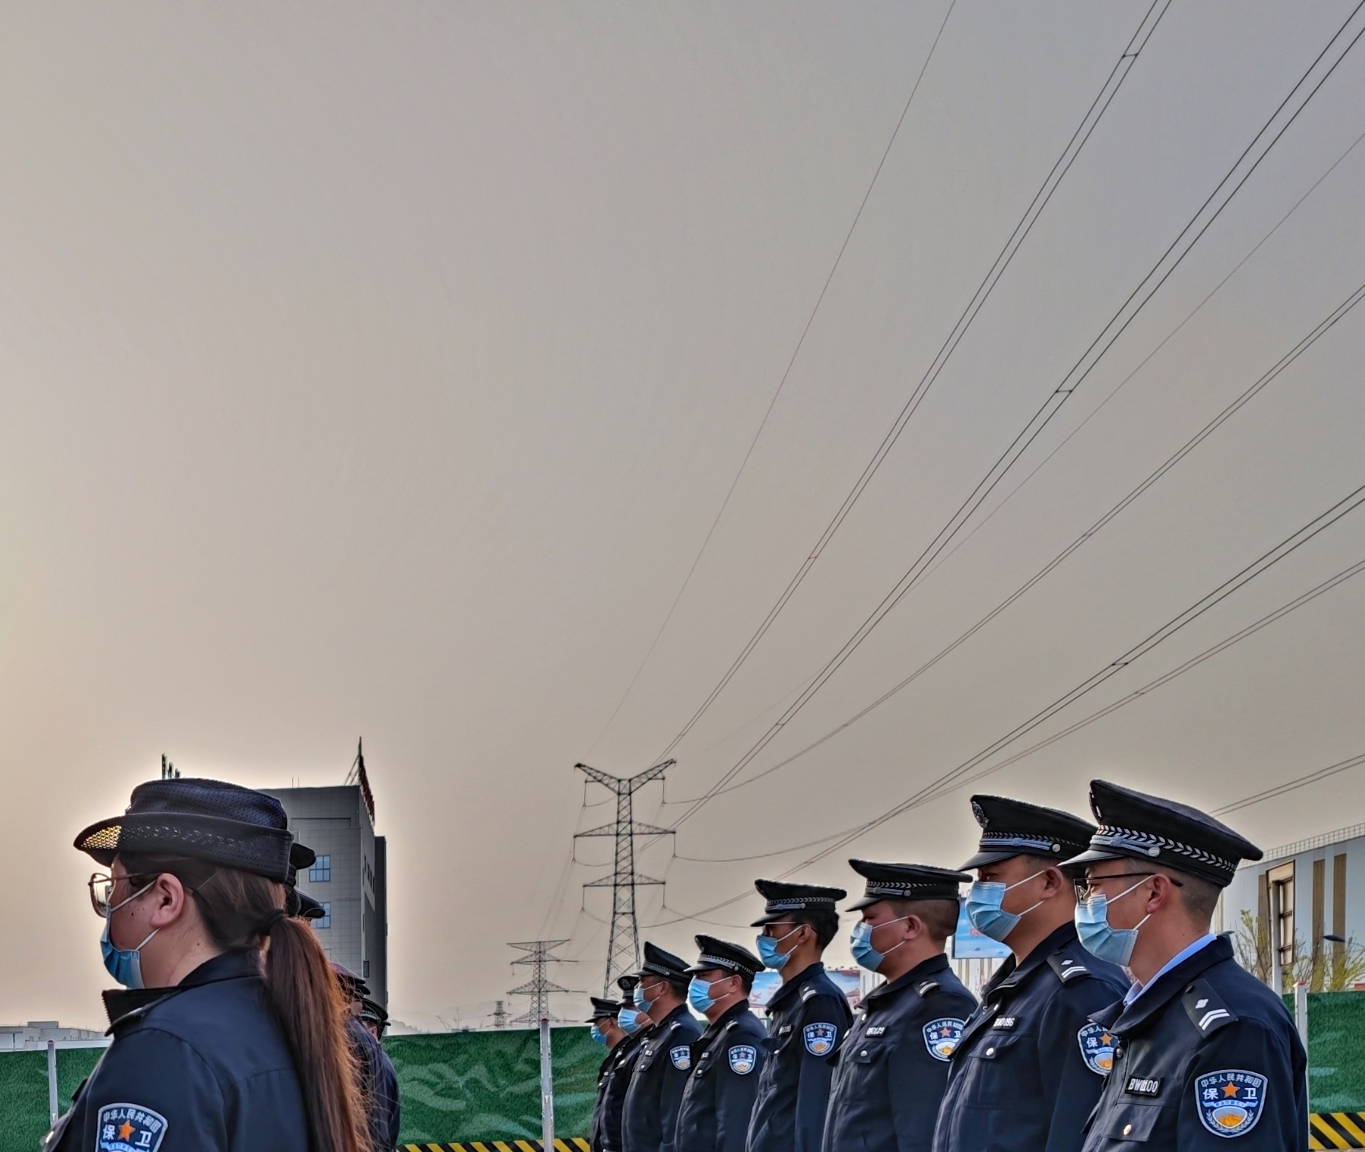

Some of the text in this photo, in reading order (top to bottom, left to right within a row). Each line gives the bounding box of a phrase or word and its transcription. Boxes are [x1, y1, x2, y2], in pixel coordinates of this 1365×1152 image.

[1200, 1072, 1263, 1088] 中华人民共和国
[1202, 1087, 1258, 1100] 保 卫
[103, 1108, 162, 1134] 中华人民共和国
[102, 1124, 152, 1148] 保 卫
